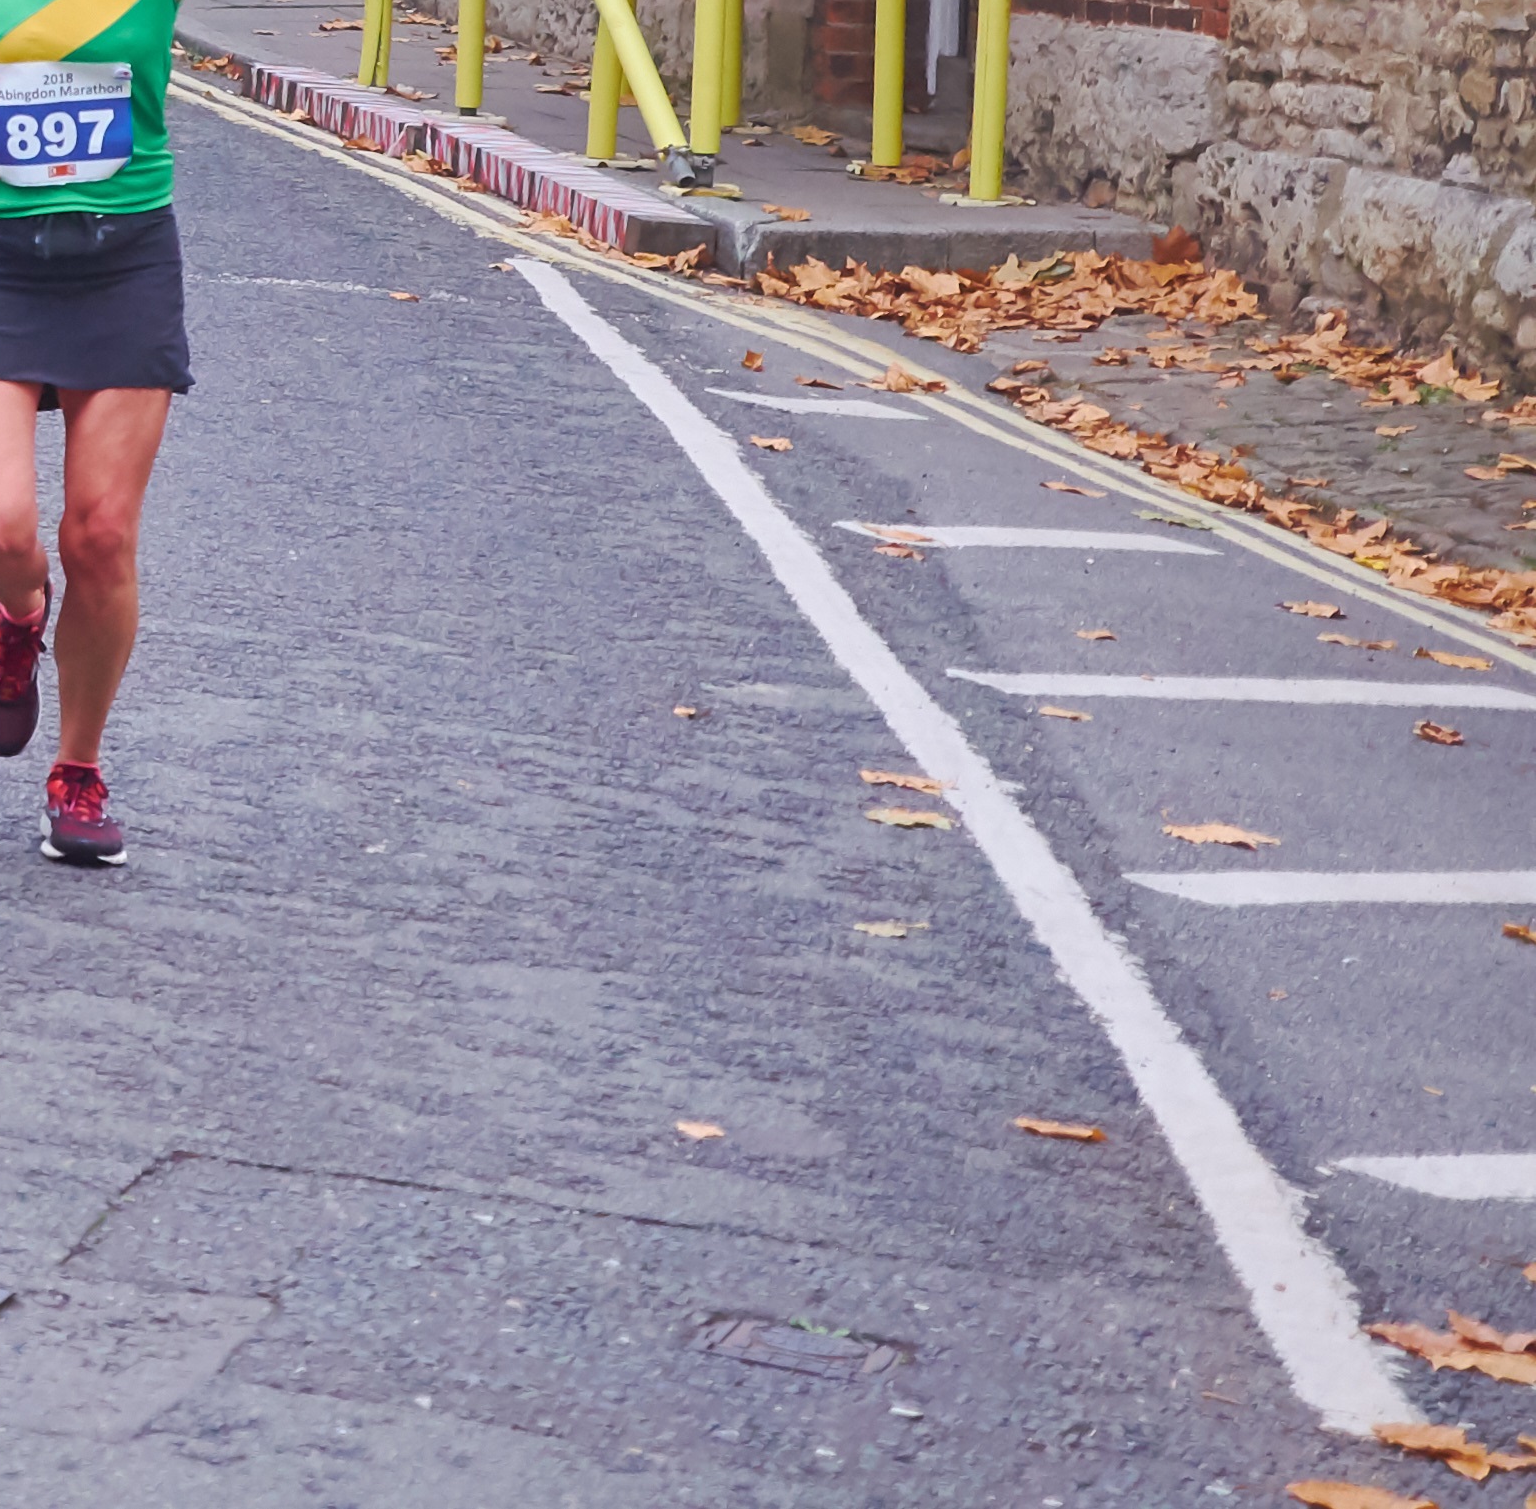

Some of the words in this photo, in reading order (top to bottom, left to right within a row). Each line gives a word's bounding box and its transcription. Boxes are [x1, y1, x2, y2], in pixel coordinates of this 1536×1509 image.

[43, 72, 74, 86] 2018
[59, 82, 123, 97] Marathon
[6, 109, 115, 160] 897
